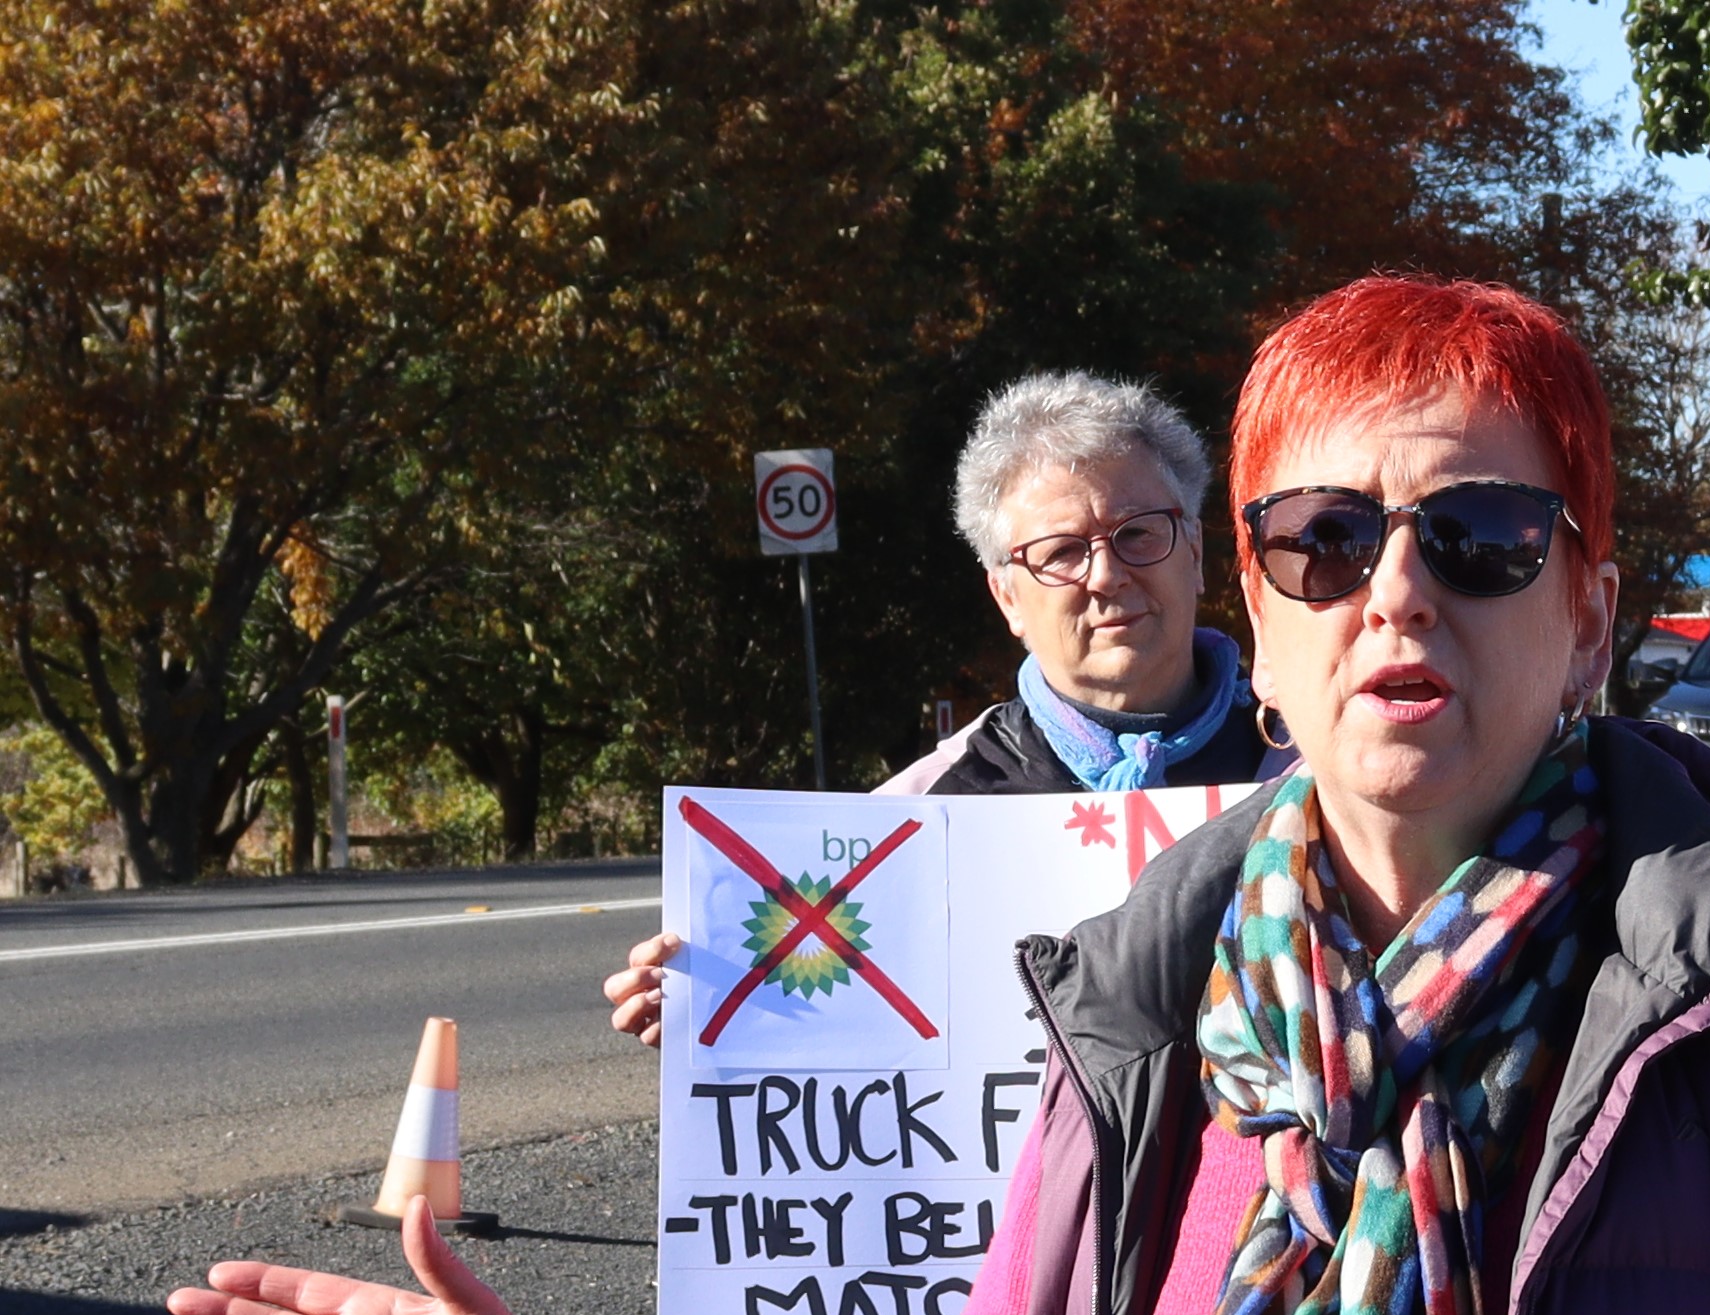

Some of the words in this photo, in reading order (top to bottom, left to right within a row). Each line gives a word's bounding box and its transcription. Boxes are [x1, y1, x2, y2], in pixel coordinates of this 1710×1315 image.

[773, 484, 821, 519] 50
[822, 829, 872, 870] bp
[691, 1070, 958, 1177] TRUCK
[982, 1071, 1046, 1173] F
